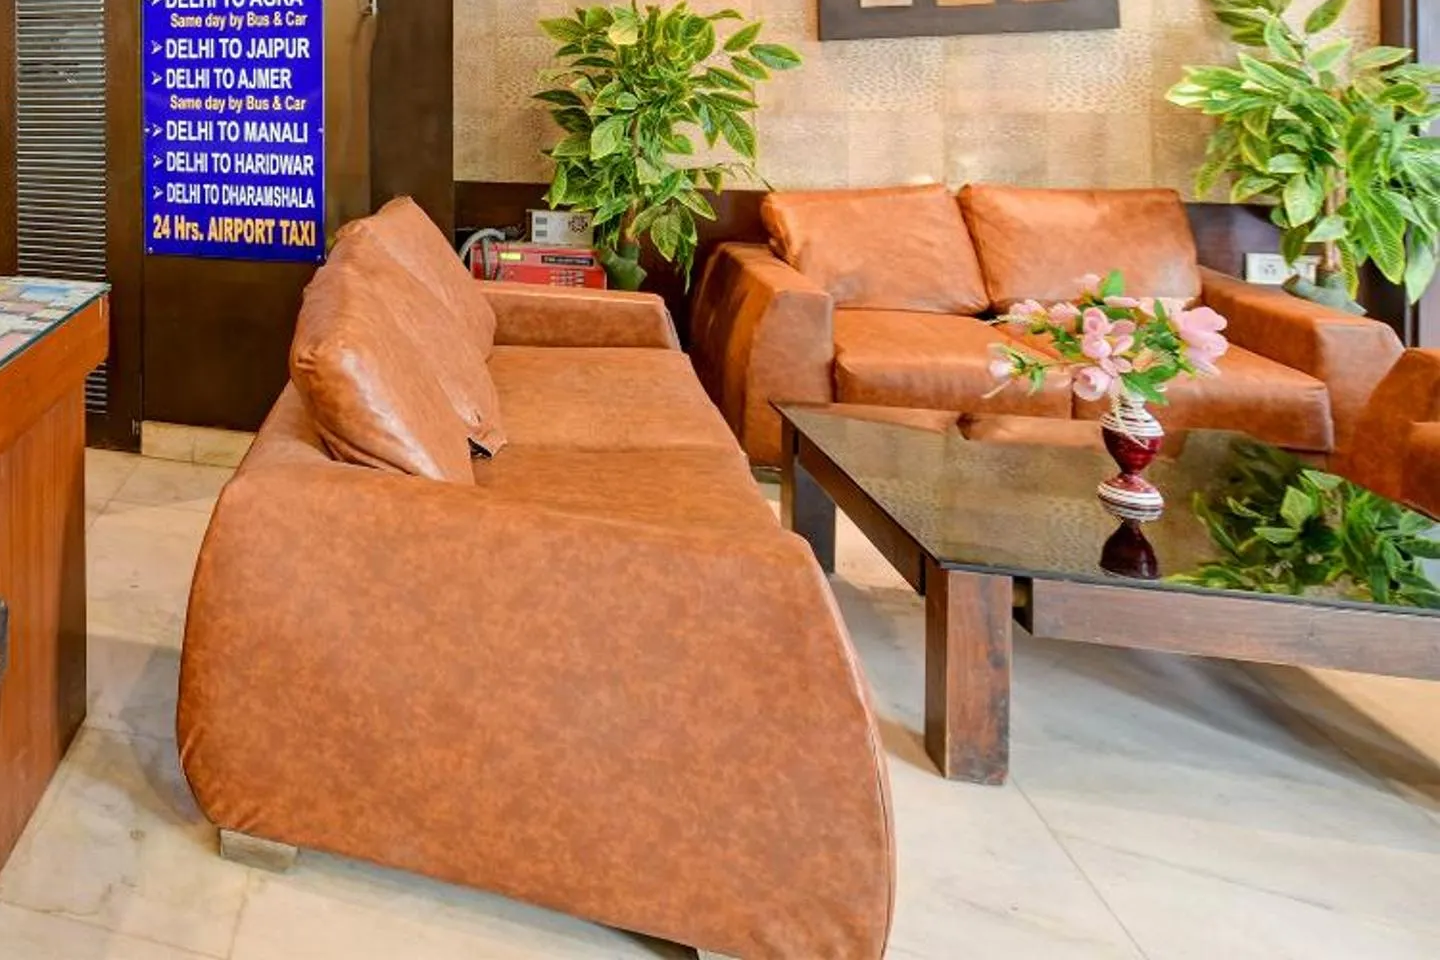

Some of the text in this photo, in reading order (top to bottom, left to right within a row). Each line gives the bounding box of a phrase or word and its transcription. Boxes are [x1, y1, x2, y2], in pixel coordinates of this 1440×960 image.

[170, 11, 309, 31] Same day by Bus & Car
[165, 37, 310, 60] DELHI TO JAIPUR
[166, 68, 292, 90] DELHI TO AJMER
[170, 95, 307, 114] Same day by Bus & Car
[166, 121, 309, 143] DELHI TO MANALI
[166, 152, 315, 176] DELHI TO HARIDWAR
[166, 182, 315, 208] DELHI TO DHARAMSHALA
[152, 214, 316, 247] 24 Hrs. AIRPORT TAXI
